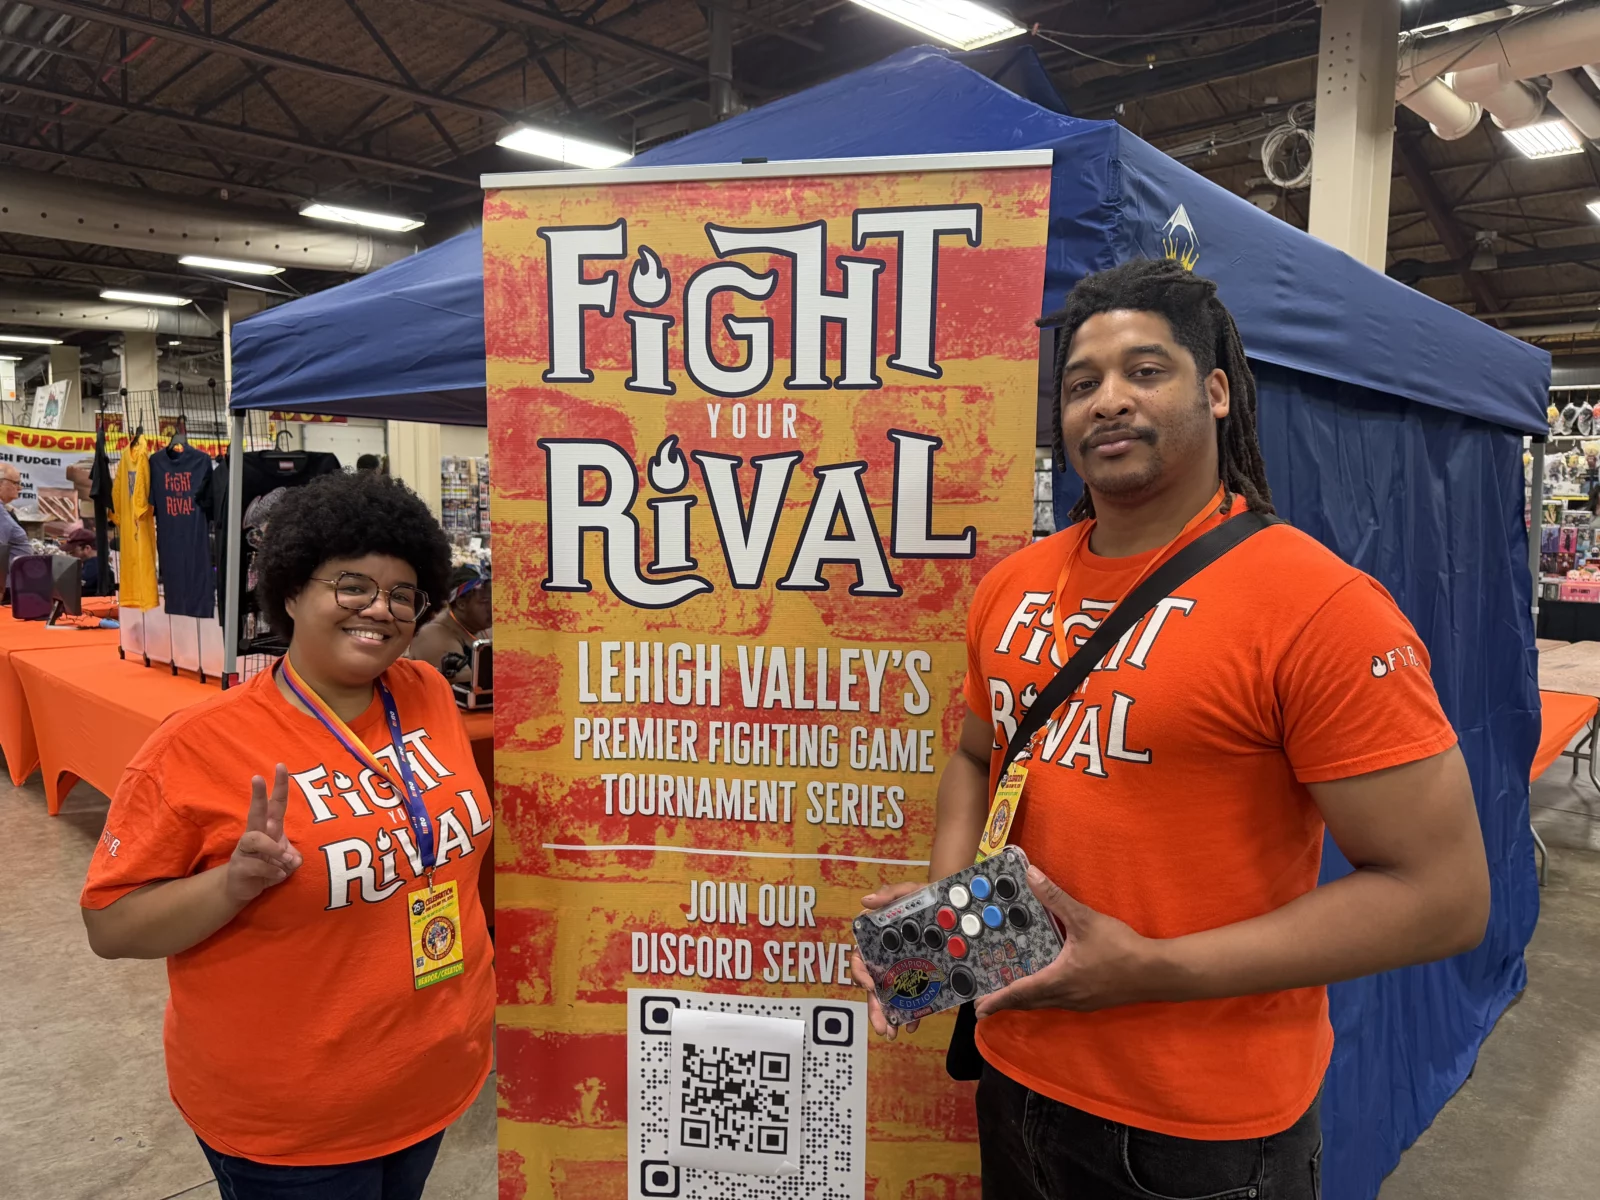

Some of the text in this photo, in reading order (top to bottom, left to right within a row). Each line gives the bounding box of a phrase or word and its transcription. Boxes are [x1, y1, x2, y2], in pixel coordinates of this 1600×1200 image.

[705, 402, 798, 440] YOUR
[16, 454, 61, 466] FUDGE!
[578, 641, 932, 715] LEHIGH VALLEY'S
[1385, 646, 1419, 672] FYR
[574, 717, 934, 772] PREMIER FIGHTING GAME
[388, 807, 407, 824] YO
[601, 773, 905, 829] TOURNAMENT SERIES
[686, 880, 817, 927] JOIN OUR
[631, 931, 857, 985] DISCORD SERVE
[887, 961, 929, 984] CHAMPION
[899, 987, 936, 1008] EDITION
